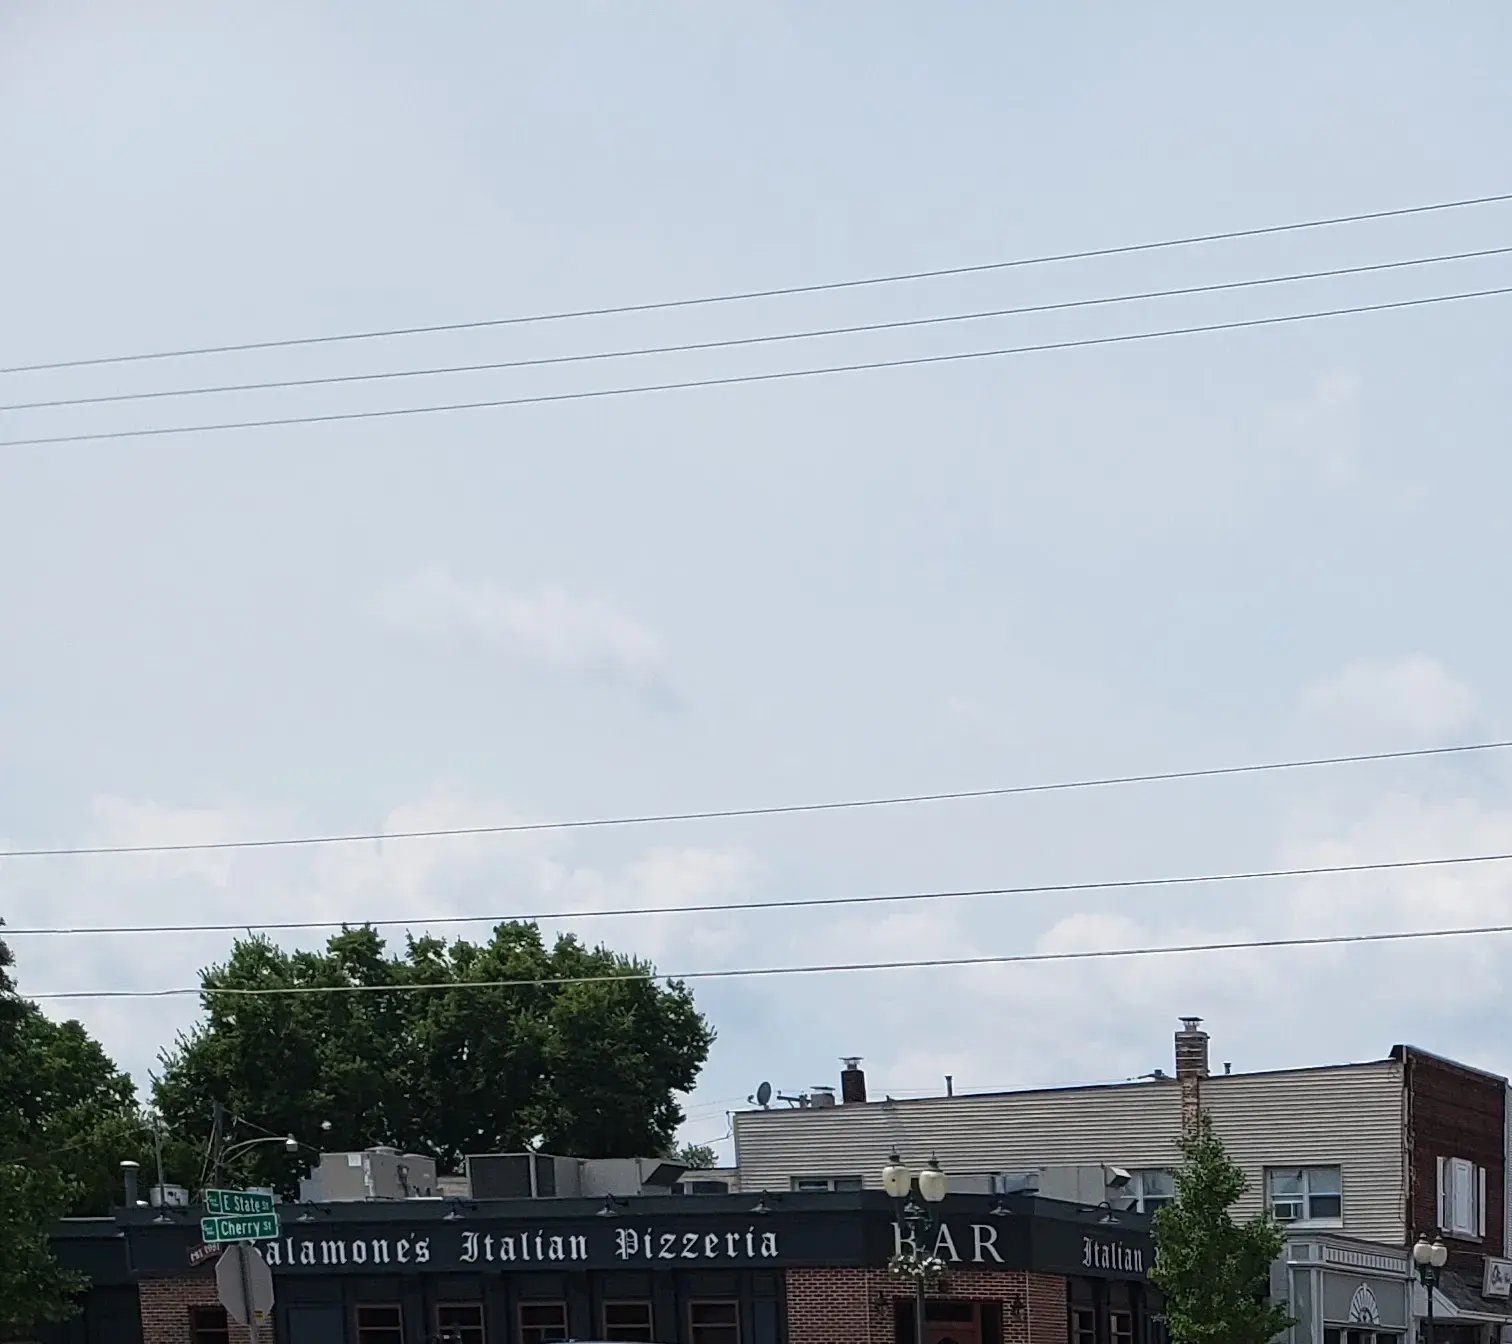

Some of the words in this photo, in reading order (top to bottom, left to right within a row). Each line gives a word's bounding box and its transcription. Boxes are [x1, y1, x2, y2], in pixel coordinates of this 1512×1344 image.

[224, 1195, 230, 1210] E
[234, 1195, 260, 1212] State
[262, 1201, 269, 1210] St
[221, 1221, 260, 1237] Cherry
[263, 1221, 272, 1231] St
[250, 1232, 430, 1267] alamone's
[459, 1229, 588, 1263] Italian
[615, 1226, 779, 1260] Pizzeria
[1082, 1236, 1143, 1272] Italian
